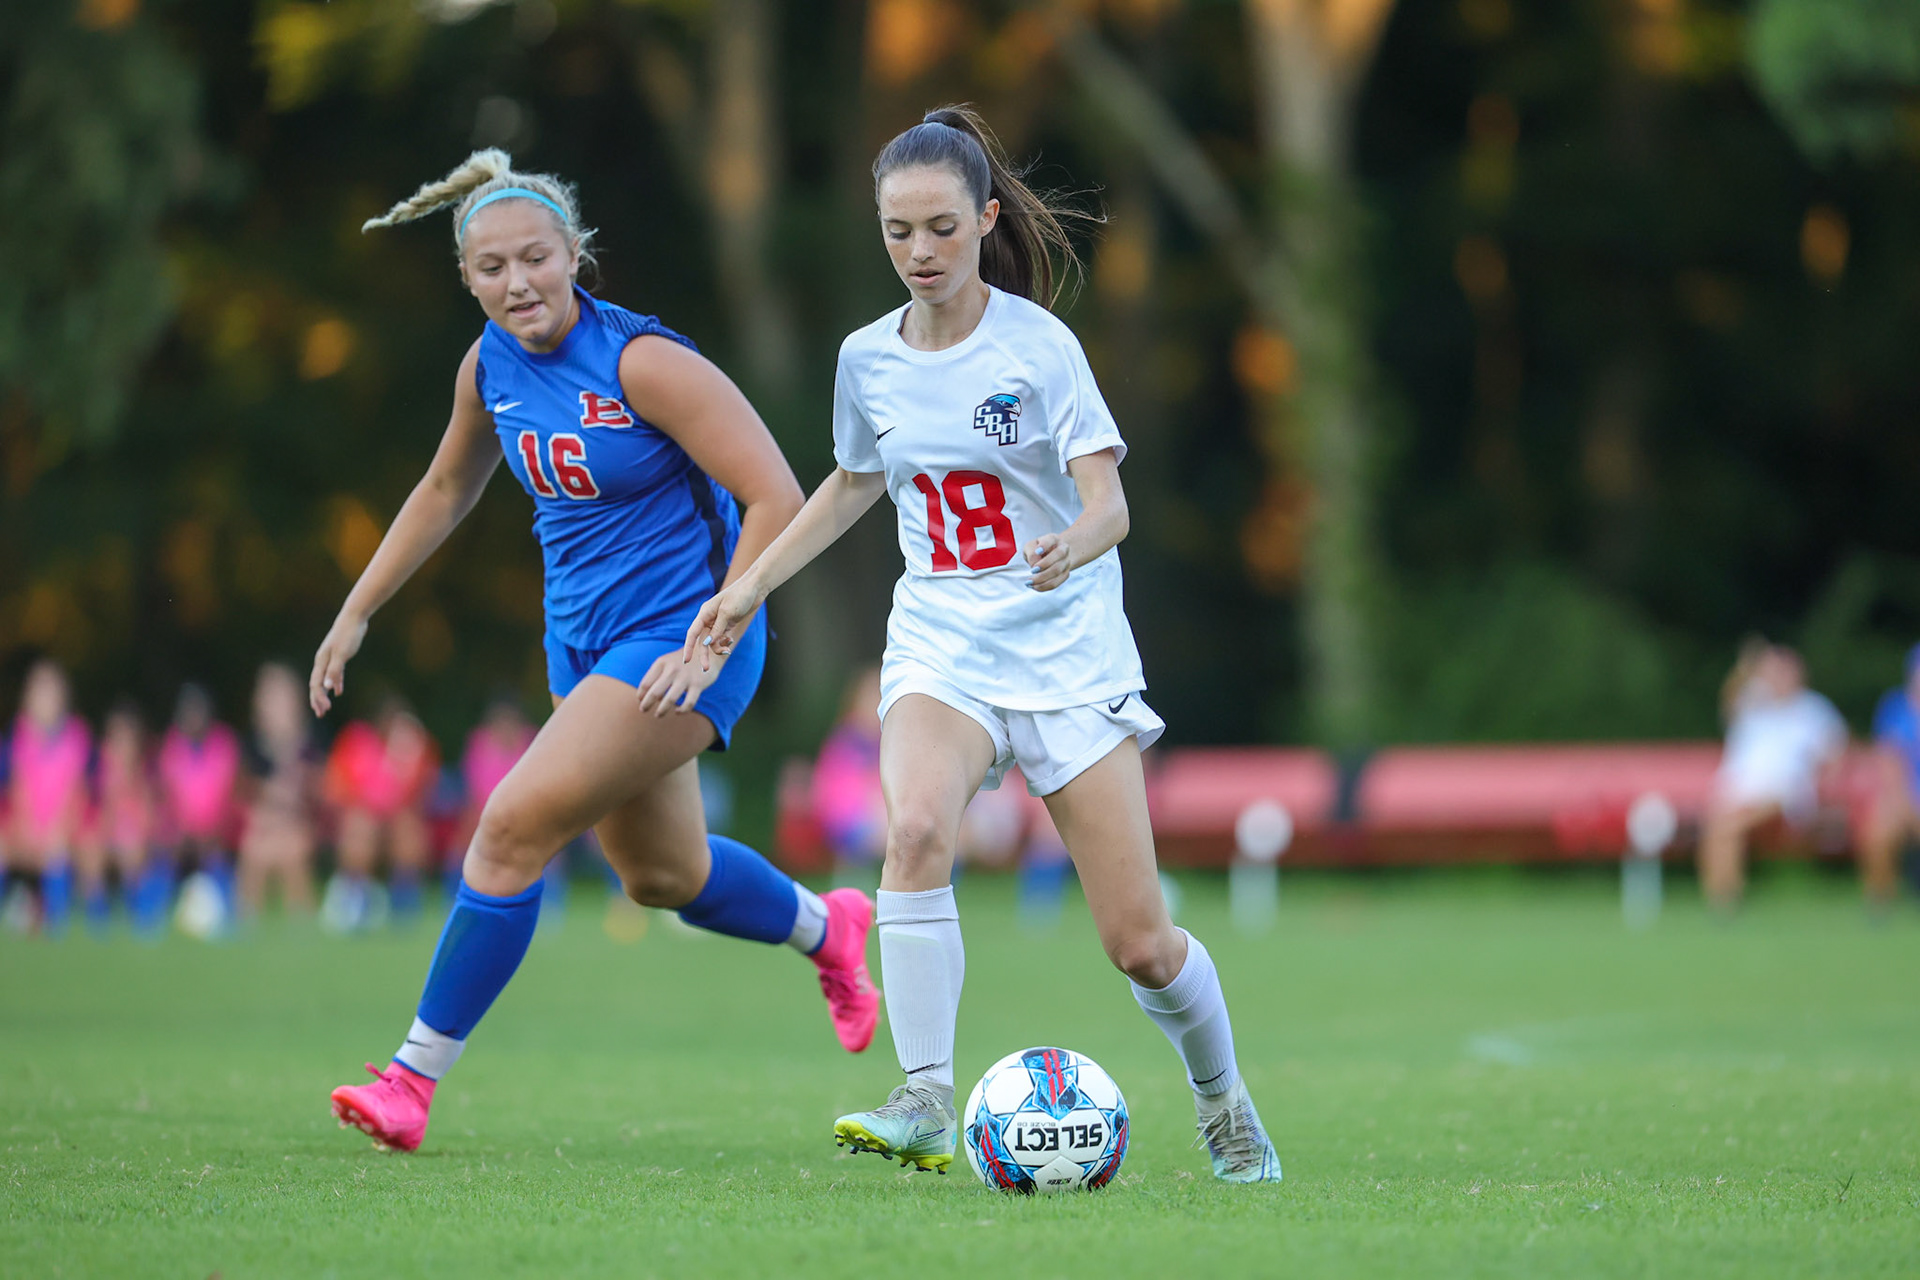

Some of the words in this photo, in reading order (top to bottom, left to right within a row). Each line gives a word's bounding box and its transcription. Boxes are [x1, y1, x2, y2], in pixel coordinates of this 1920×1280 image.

[975, 405, 1017, 445] SBA
[518, 430, 600, 500] 16
[911, 470, 1018, 573] 18
[1015, 1123, 1103, 1151] SELECT
